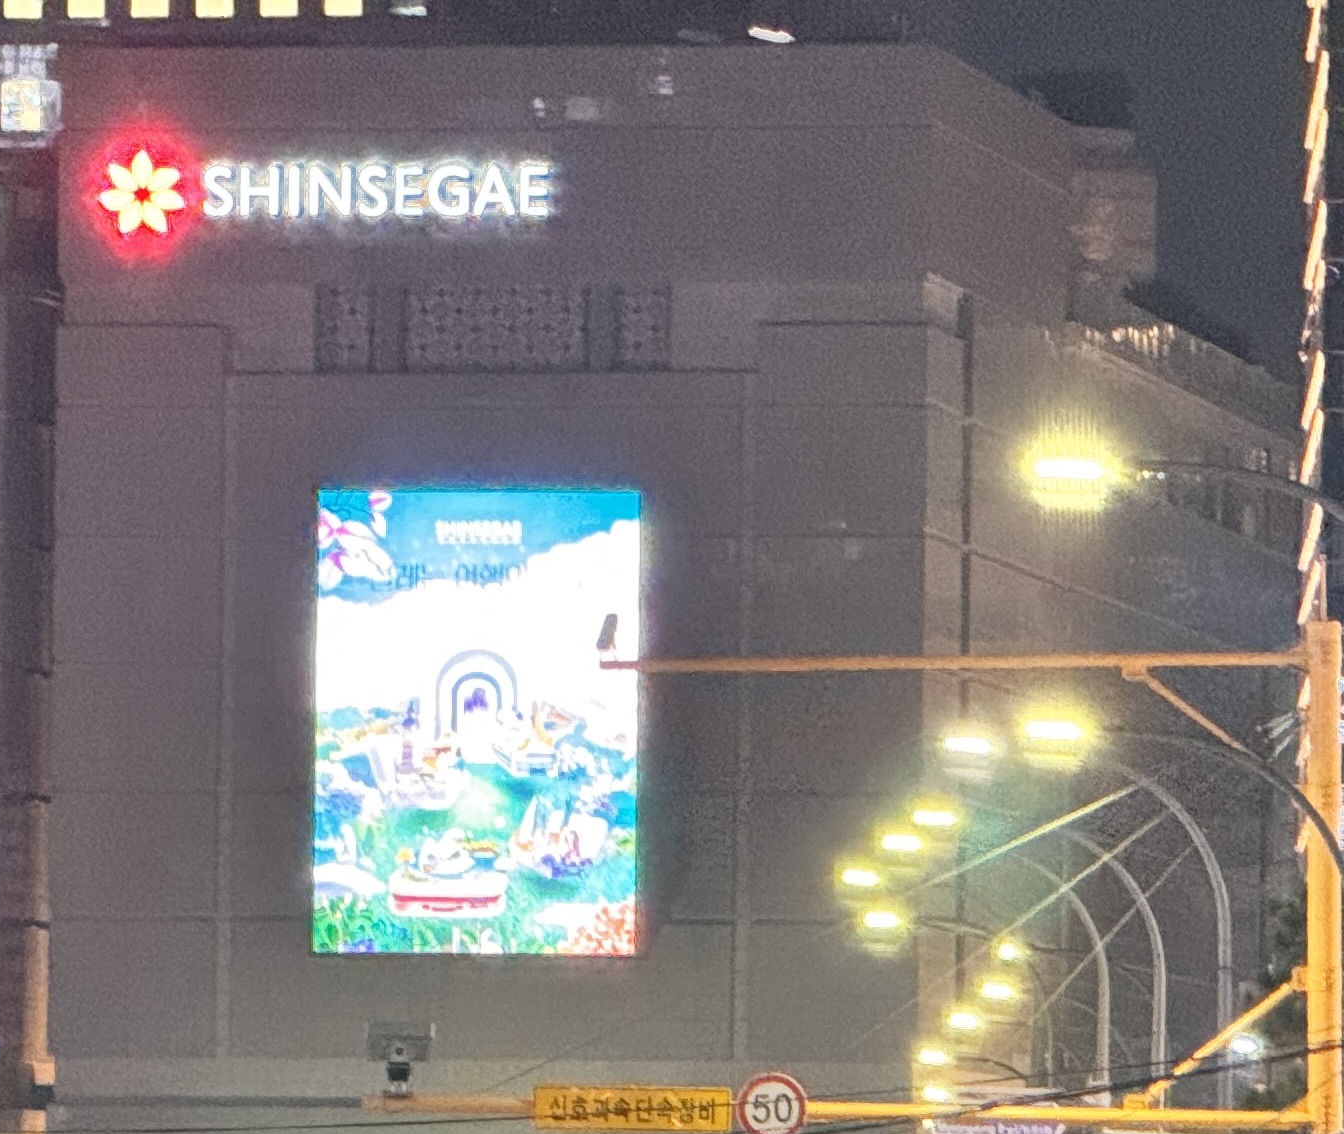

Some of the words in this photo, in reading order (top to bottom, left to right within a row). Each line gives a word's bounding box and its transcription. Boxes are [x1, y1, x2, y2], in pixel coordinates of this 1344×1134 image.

[202, 162, 555, 219] SHINSEGAE
[548, 1093, 718, 1126] 신호과속단속장비
[752, 1096, 794, 1126] 50
